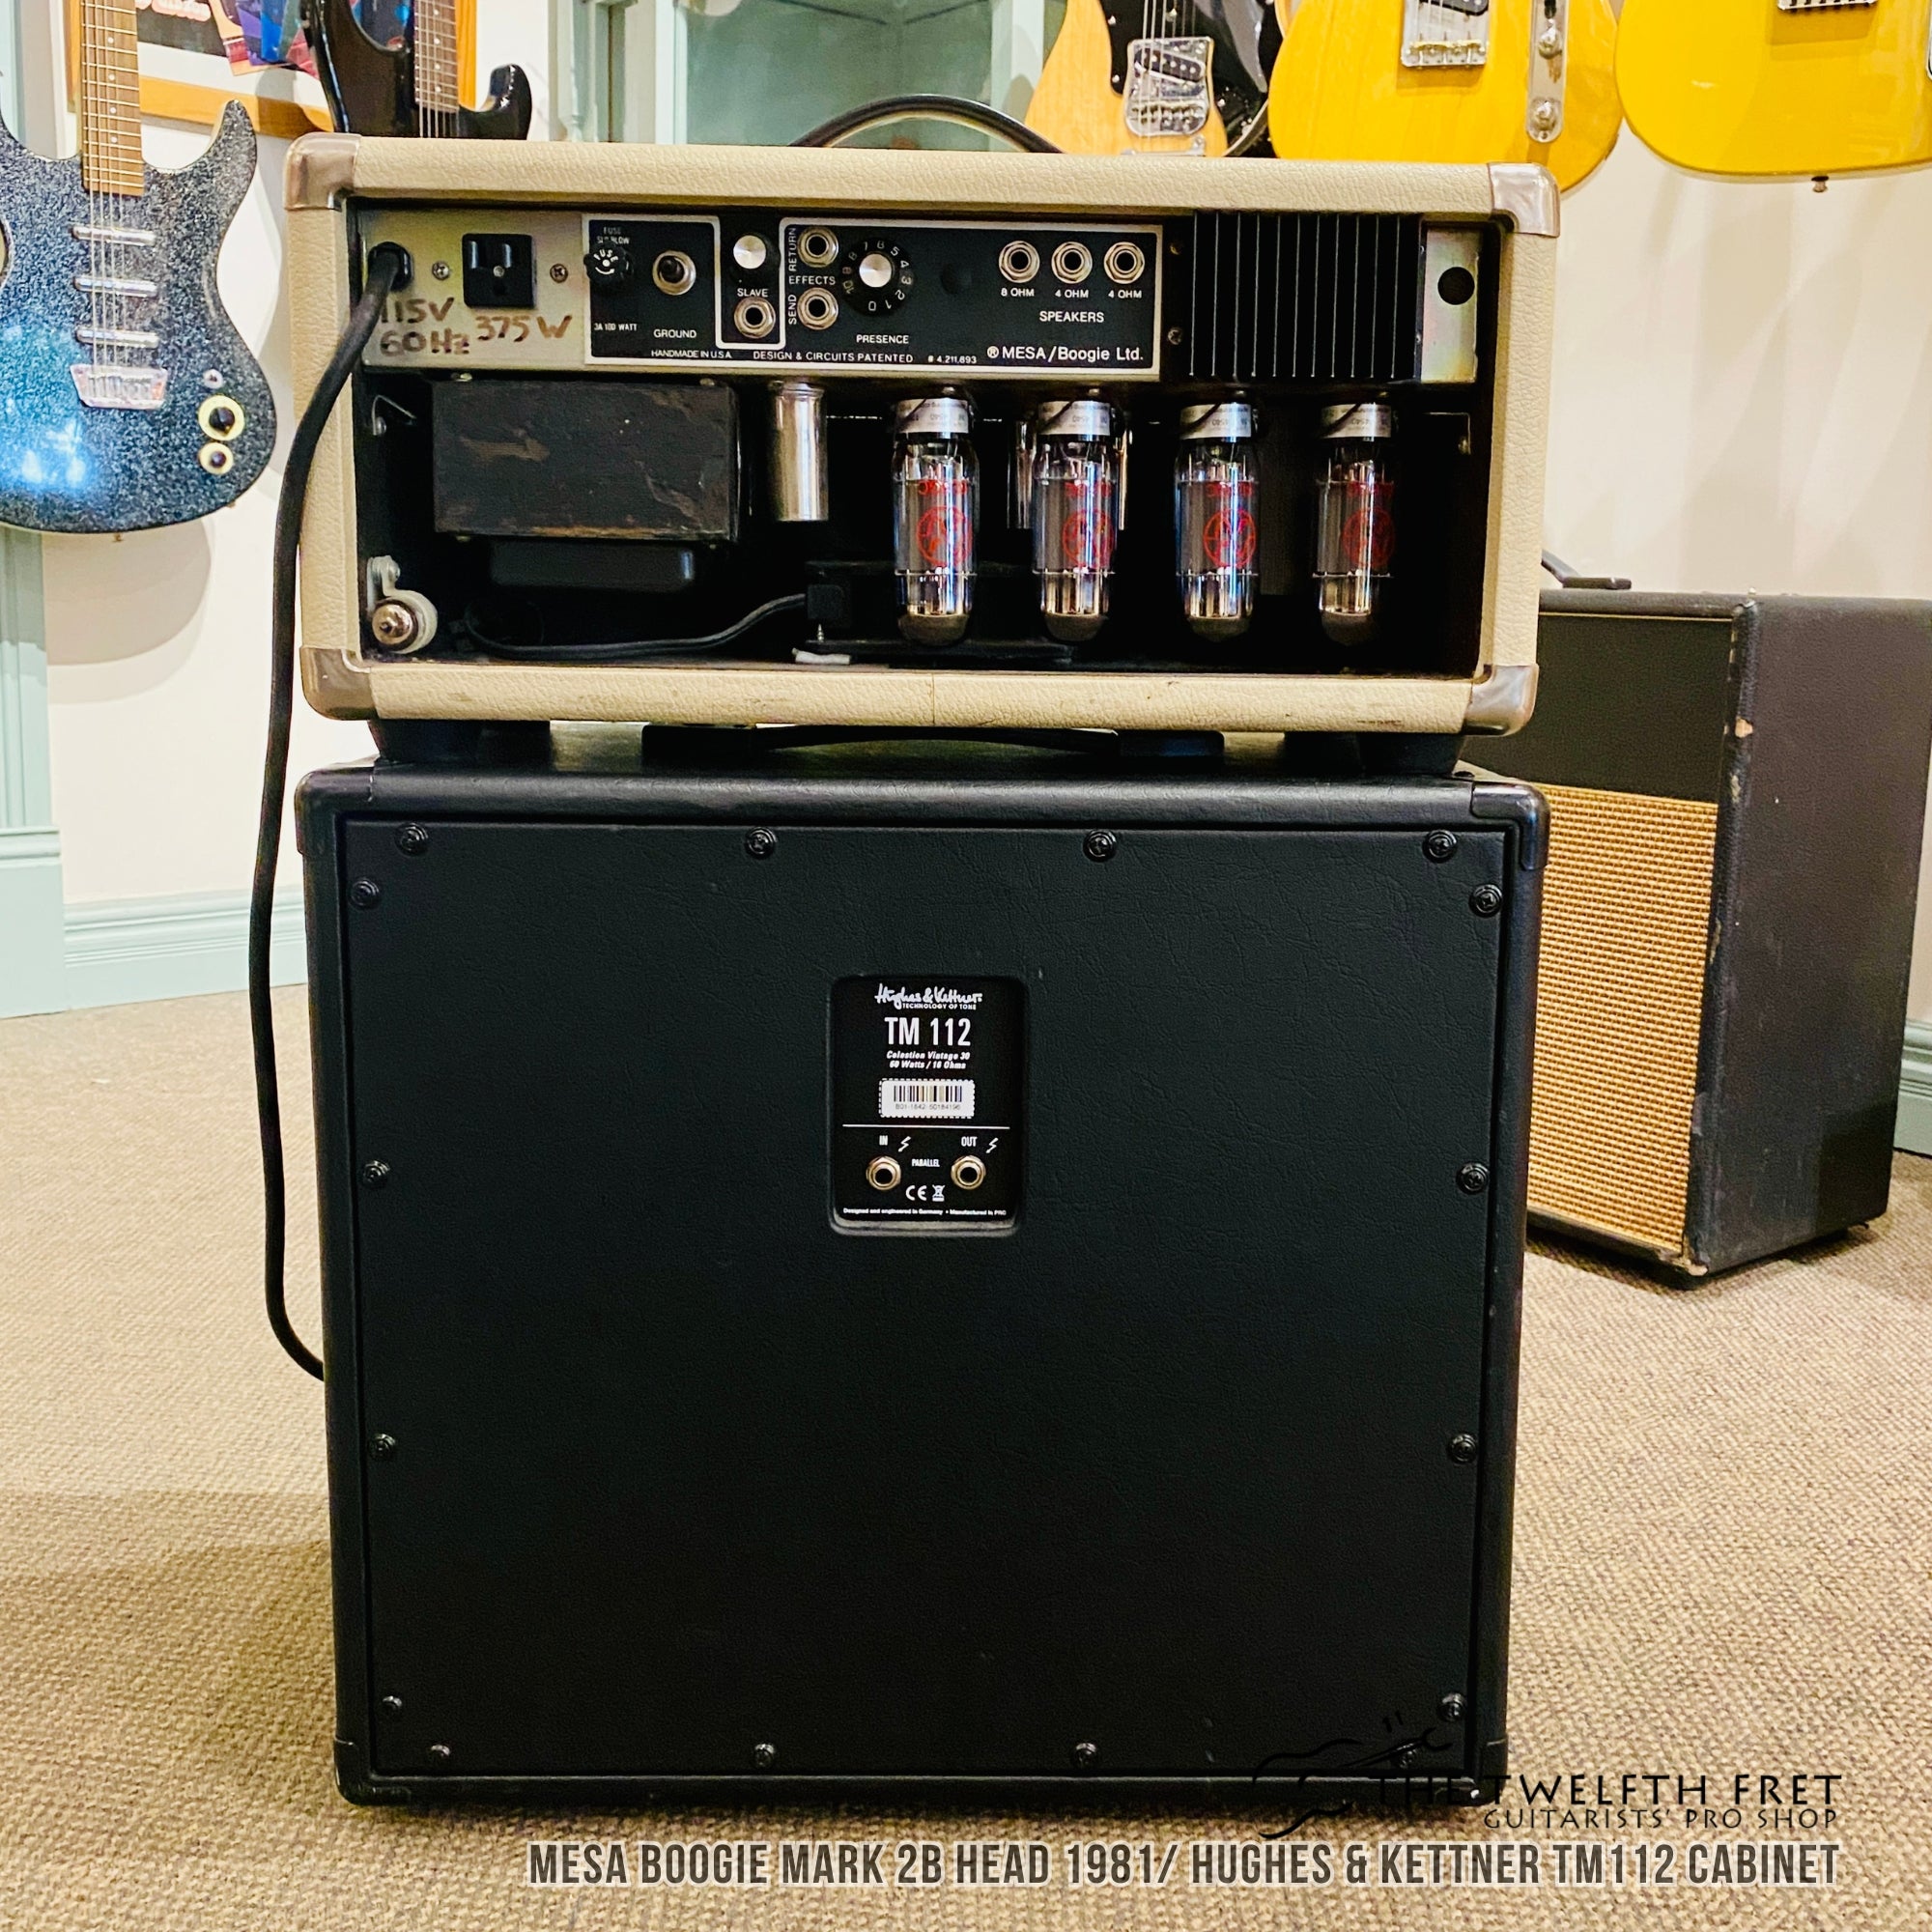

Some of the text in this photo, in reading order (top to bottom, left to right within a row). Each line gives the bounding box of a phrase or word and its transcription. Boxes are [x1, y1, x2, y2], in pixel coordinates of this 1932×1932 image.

[788, 227, 797, 272] RETURN
[891, 246, 901, 256] 5
[593, 249, 619, 263] FUSE
[900, 260, 910, 269] 4
[789, 276, 837, 286] EFFECTS
[901, 276, 912, 285] 3
[737, 288, 769, 298] SLAVE
[895, 289, 906, 300] 2
[1001, 288, 1036, 297] 8 OHM
[1055, 289, 1089, 298] 4 OHM
[1108, 290, 1142, 298] 4 OHM
[381, 297, 455, 324] 115V
[788, 294, 797, 326] SEND
[868, 300, 876, 312] 0
[1039, 311, 1105, 323] SPEAKERS
[618, 324, 638, 332] WATT
[654, 329, 697, 339] GROUND
[857, 334, 910, 345] PRESENCE
[380, 327, 470, 357] 60Hz
[651, 350, 698, 358] HANDMADE
[753, 351, 792, 360] DESIGN
[796, 352, 802, 360] &
[806, 352, 855, 361] CIRCUITS
[858, 354, 914, 363] PATENTED
[1117, 348, 1144, 362] Ltd.
[874, 983, 983, 1010] Hughes & Kettner
[884, 1017, 972, 1046] TM 112
[887, 1050, 971, 1061] Celestion Vintage 30
[901, 1061, 924, 1069] Watts
[944, 1061, 966, 1069] Ohms
[879, 1135, 889, 1146] IN
[961, 1136, 978, 1148] OUT
[911, 1159, 940, 1168] PARALLEL
